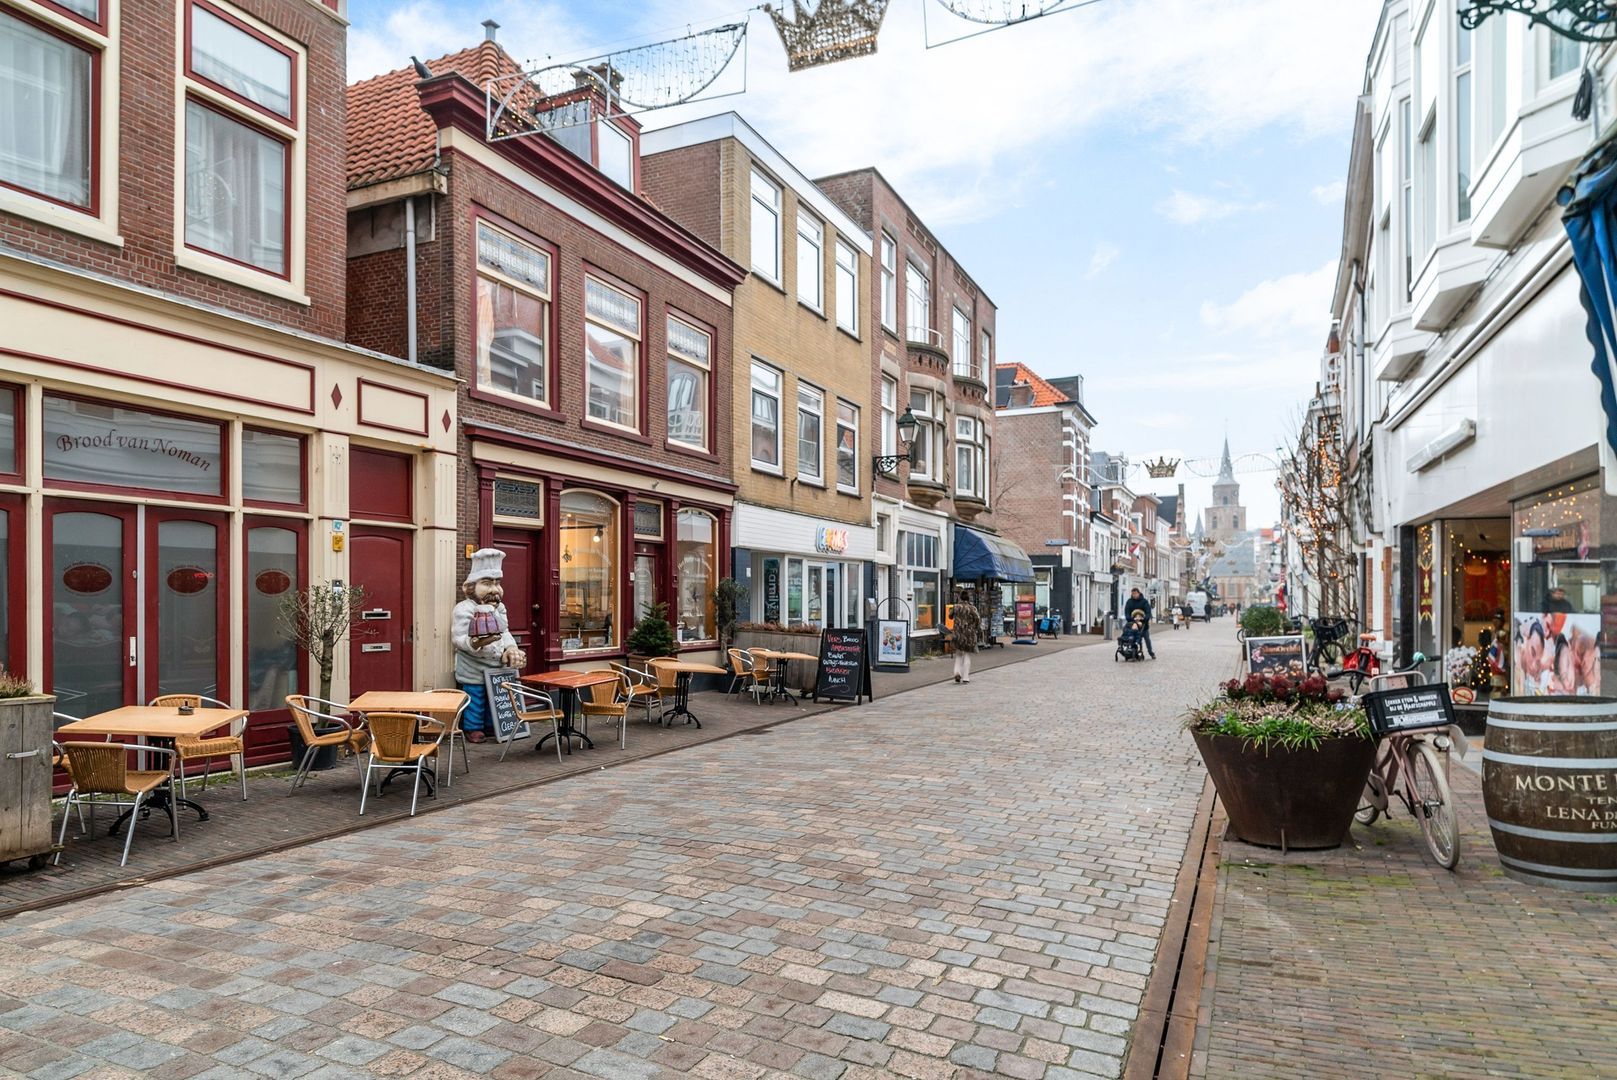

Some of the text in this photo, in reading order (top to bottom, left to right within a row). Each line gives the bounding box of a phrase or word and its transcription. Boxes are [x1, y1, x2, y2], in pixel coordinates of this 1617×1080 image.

[56, 429, 210, 472] Brood van Noman
[1517, 776, 1607, 792] MONTE
[1547, 806, 1600, 820] LENA
